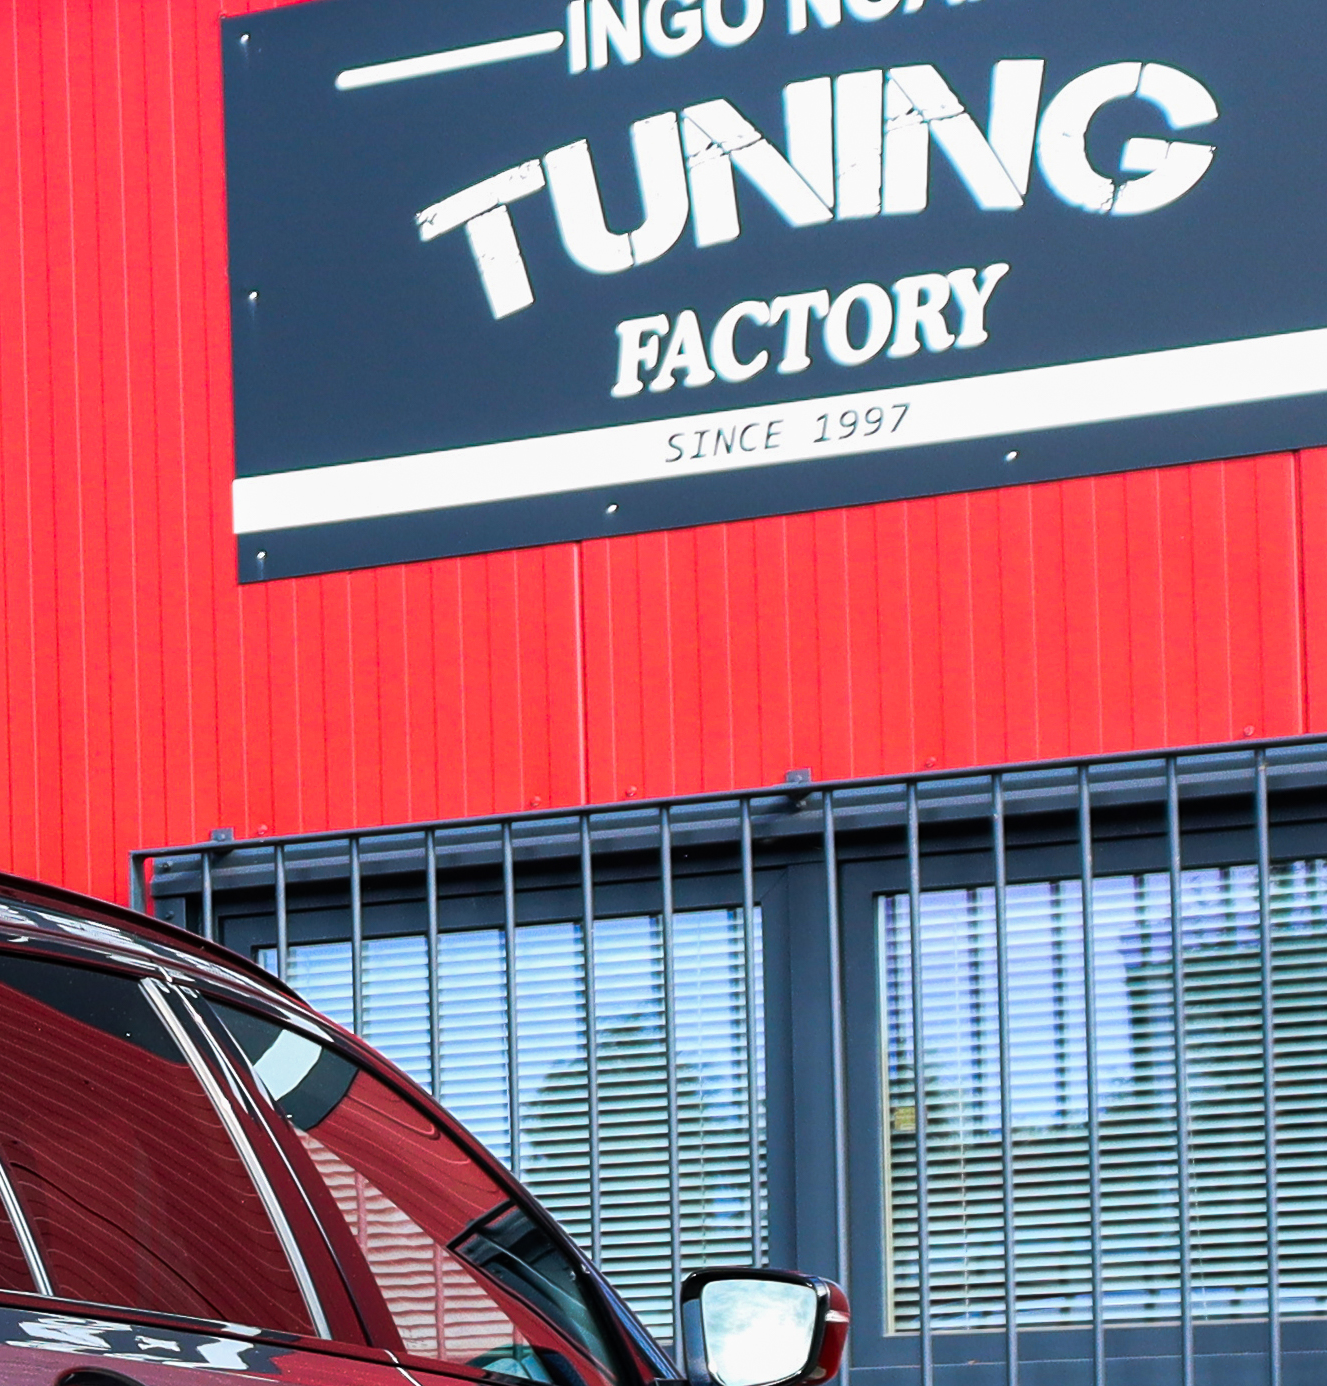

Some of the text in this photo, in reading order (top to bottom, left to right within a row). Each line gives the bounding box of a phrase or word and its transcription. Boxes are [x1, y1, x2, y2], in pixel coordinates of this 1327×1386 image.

[415, 58, 1219, 320] TUNING
[610, 262, 1010, 398] FACTORY
[664, 404, 909, 463] SINCE 1997
